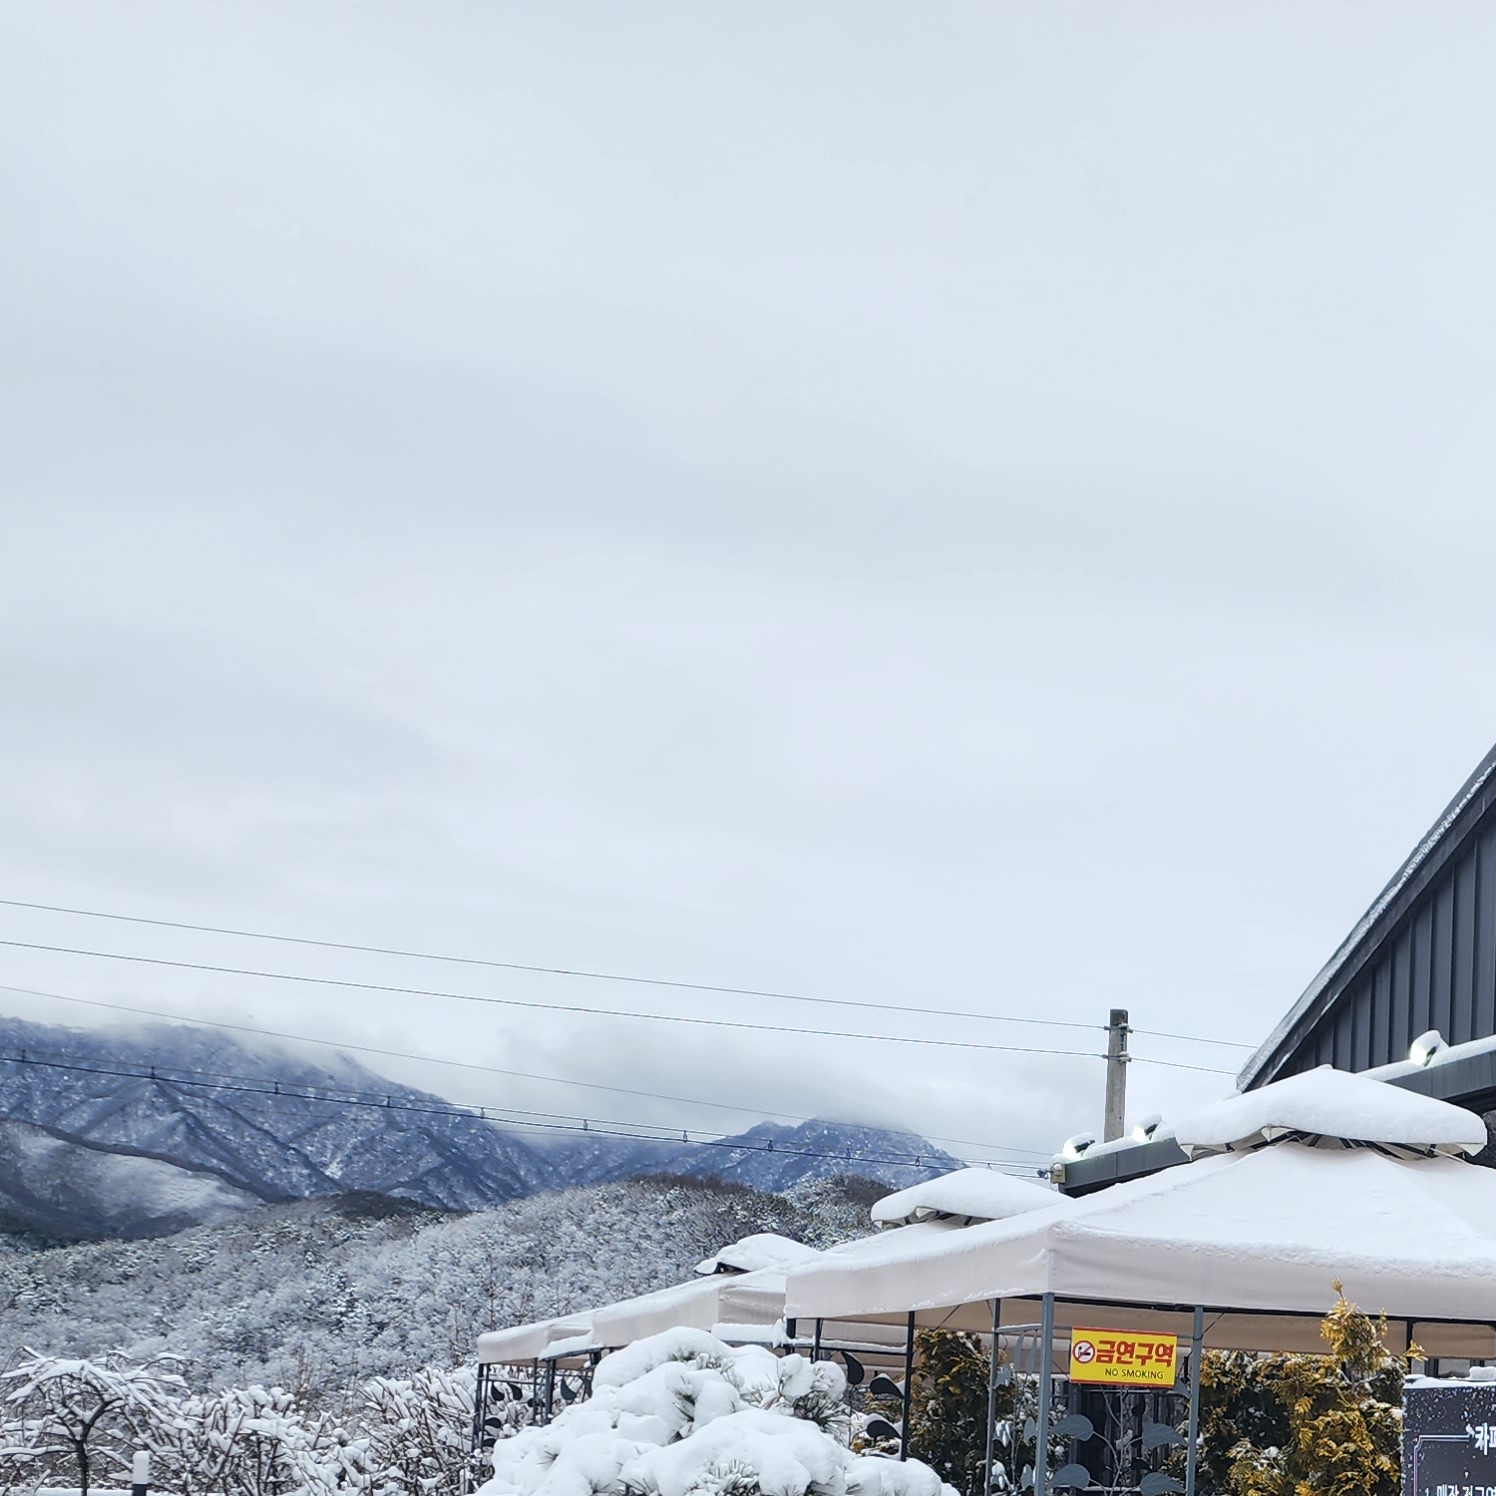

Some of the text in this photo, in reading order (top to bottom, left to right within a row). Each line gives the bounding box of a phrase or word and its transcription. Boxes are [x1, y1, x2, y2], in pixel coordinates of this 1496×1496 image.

[1096, 1339, 1175, 1368] 금연구역
[1104, 1368, 1164, 1380] NO SMOKING
